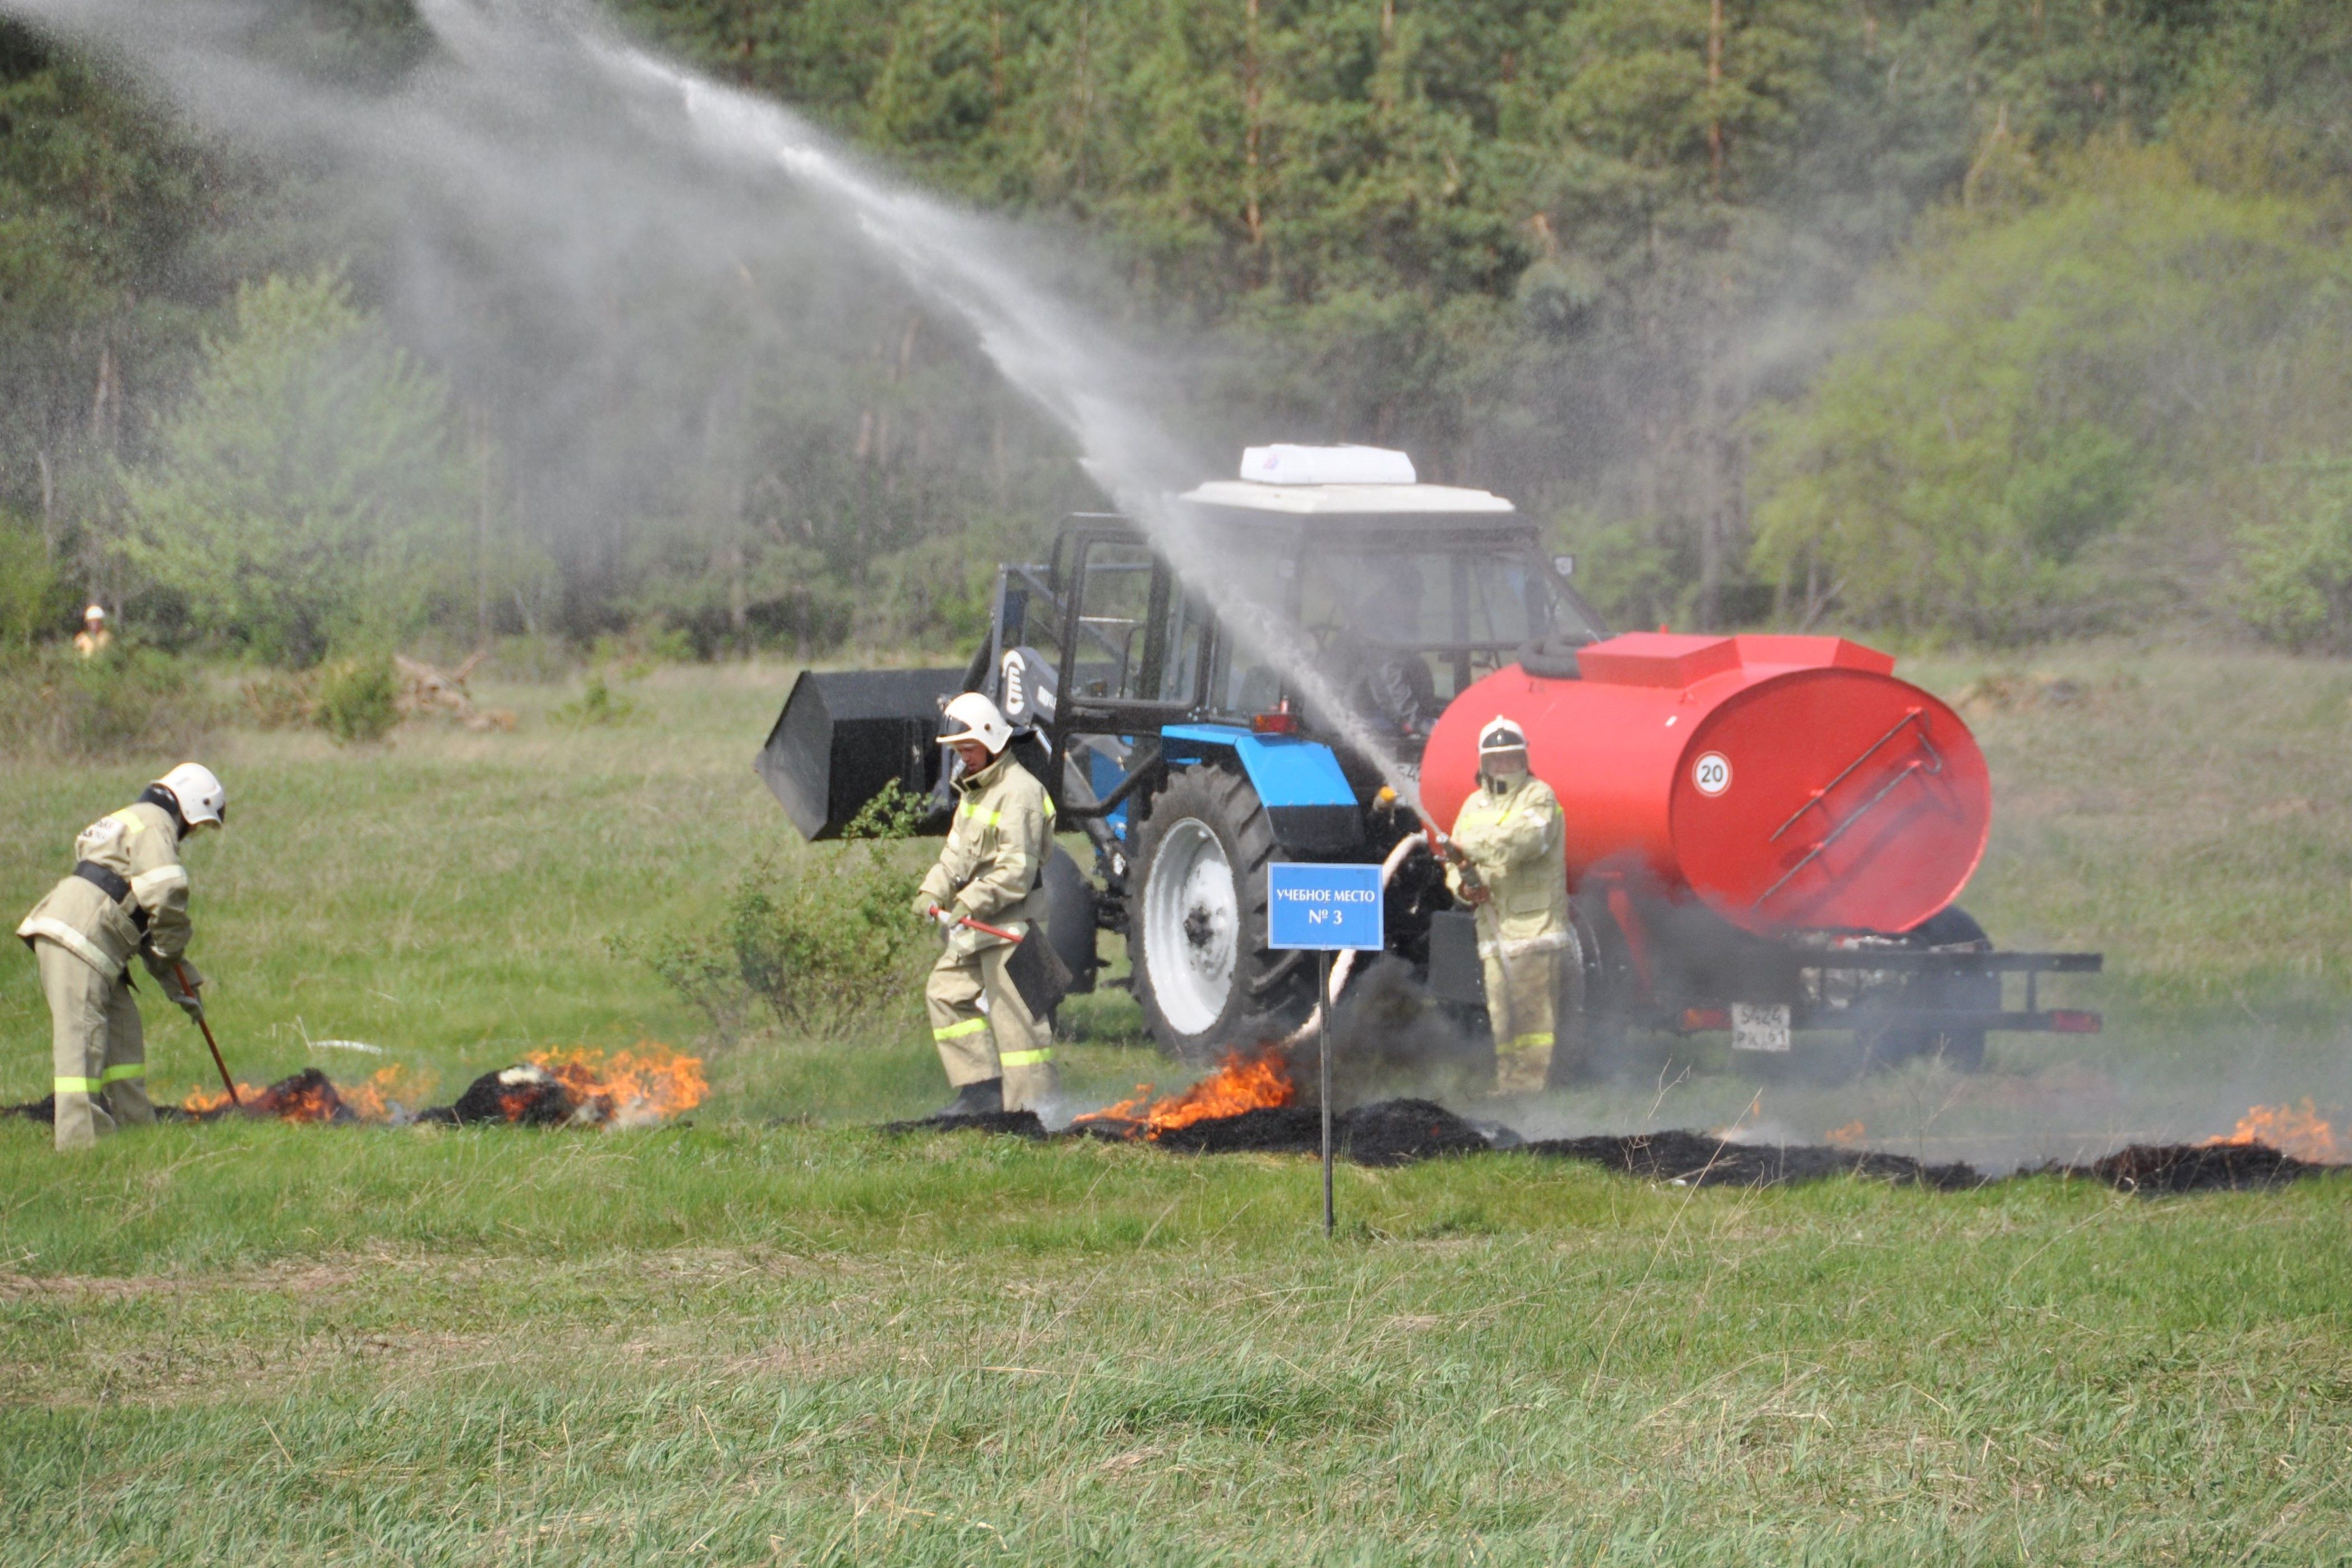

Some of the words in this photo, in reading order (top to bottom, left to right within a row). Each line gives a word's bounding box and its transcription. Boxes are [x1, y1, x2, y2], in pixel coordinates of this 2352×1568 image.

[1701, 764, 1723, 783] 20
[1276, 888, 1331, 902] УЧЕБНОЕ
[1334, 890, 1375, 902] МЕСТО
[1333, 909, 1343, 925] 3
